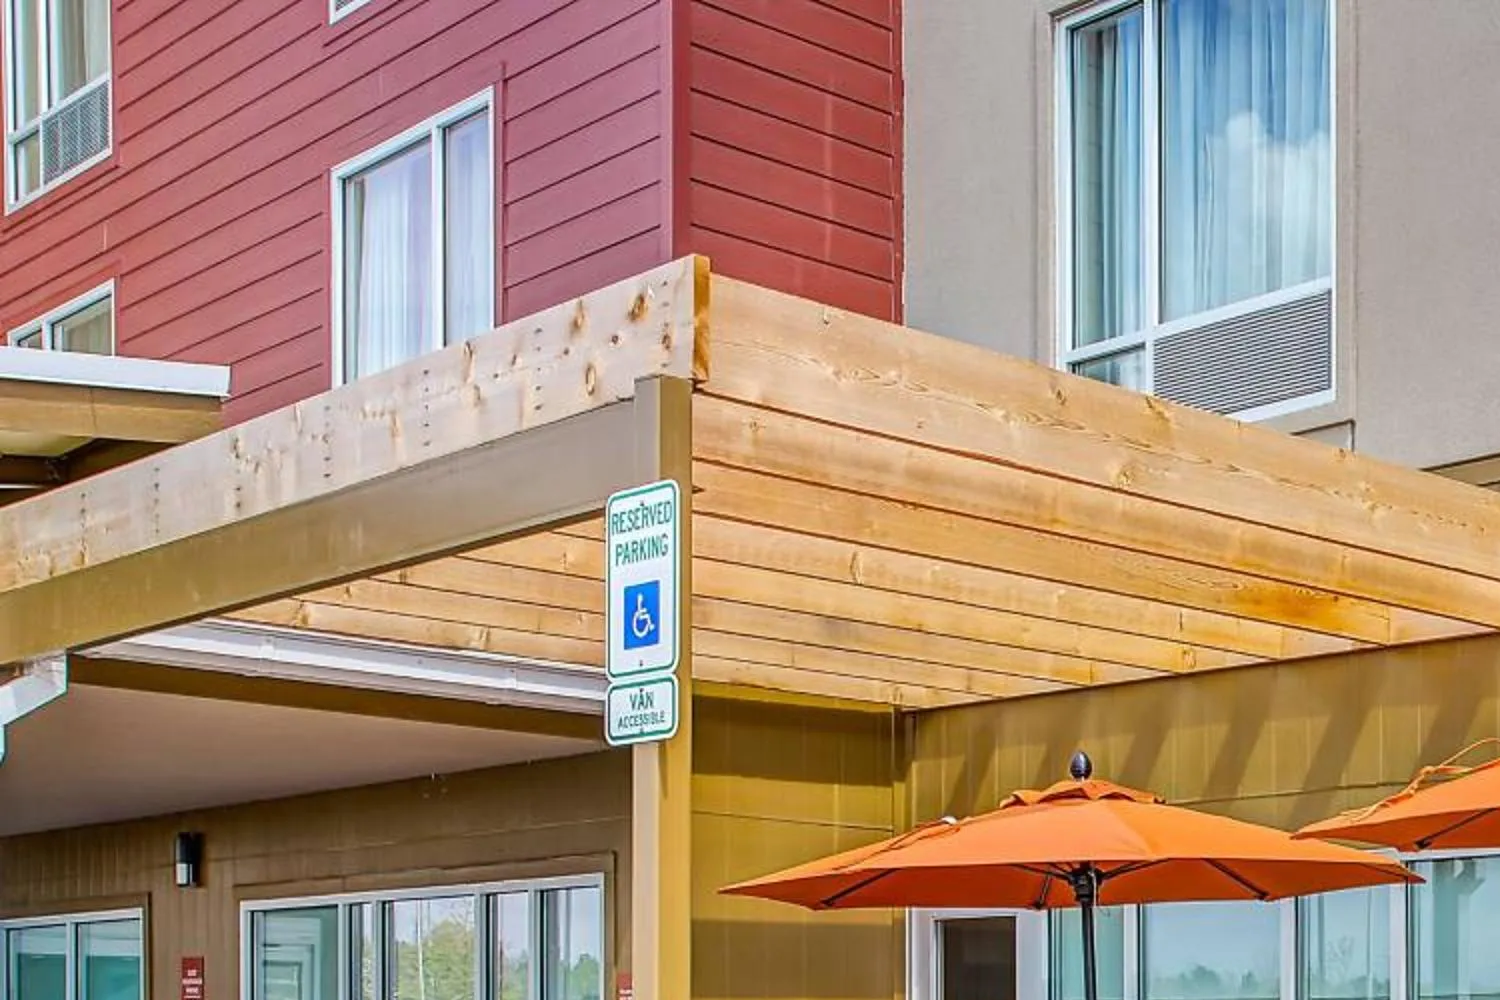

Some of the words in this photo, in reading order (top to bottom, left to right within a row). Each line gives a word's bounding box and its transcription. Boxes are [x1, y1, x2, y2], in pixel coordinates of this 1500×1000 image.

[611, 500, 673, 535] RESERVED
[615, 533, 669, 567] PARKING
[629, 691, 655, 711] VAN
[618, 709, 666, 731] ACCESSIBLE
